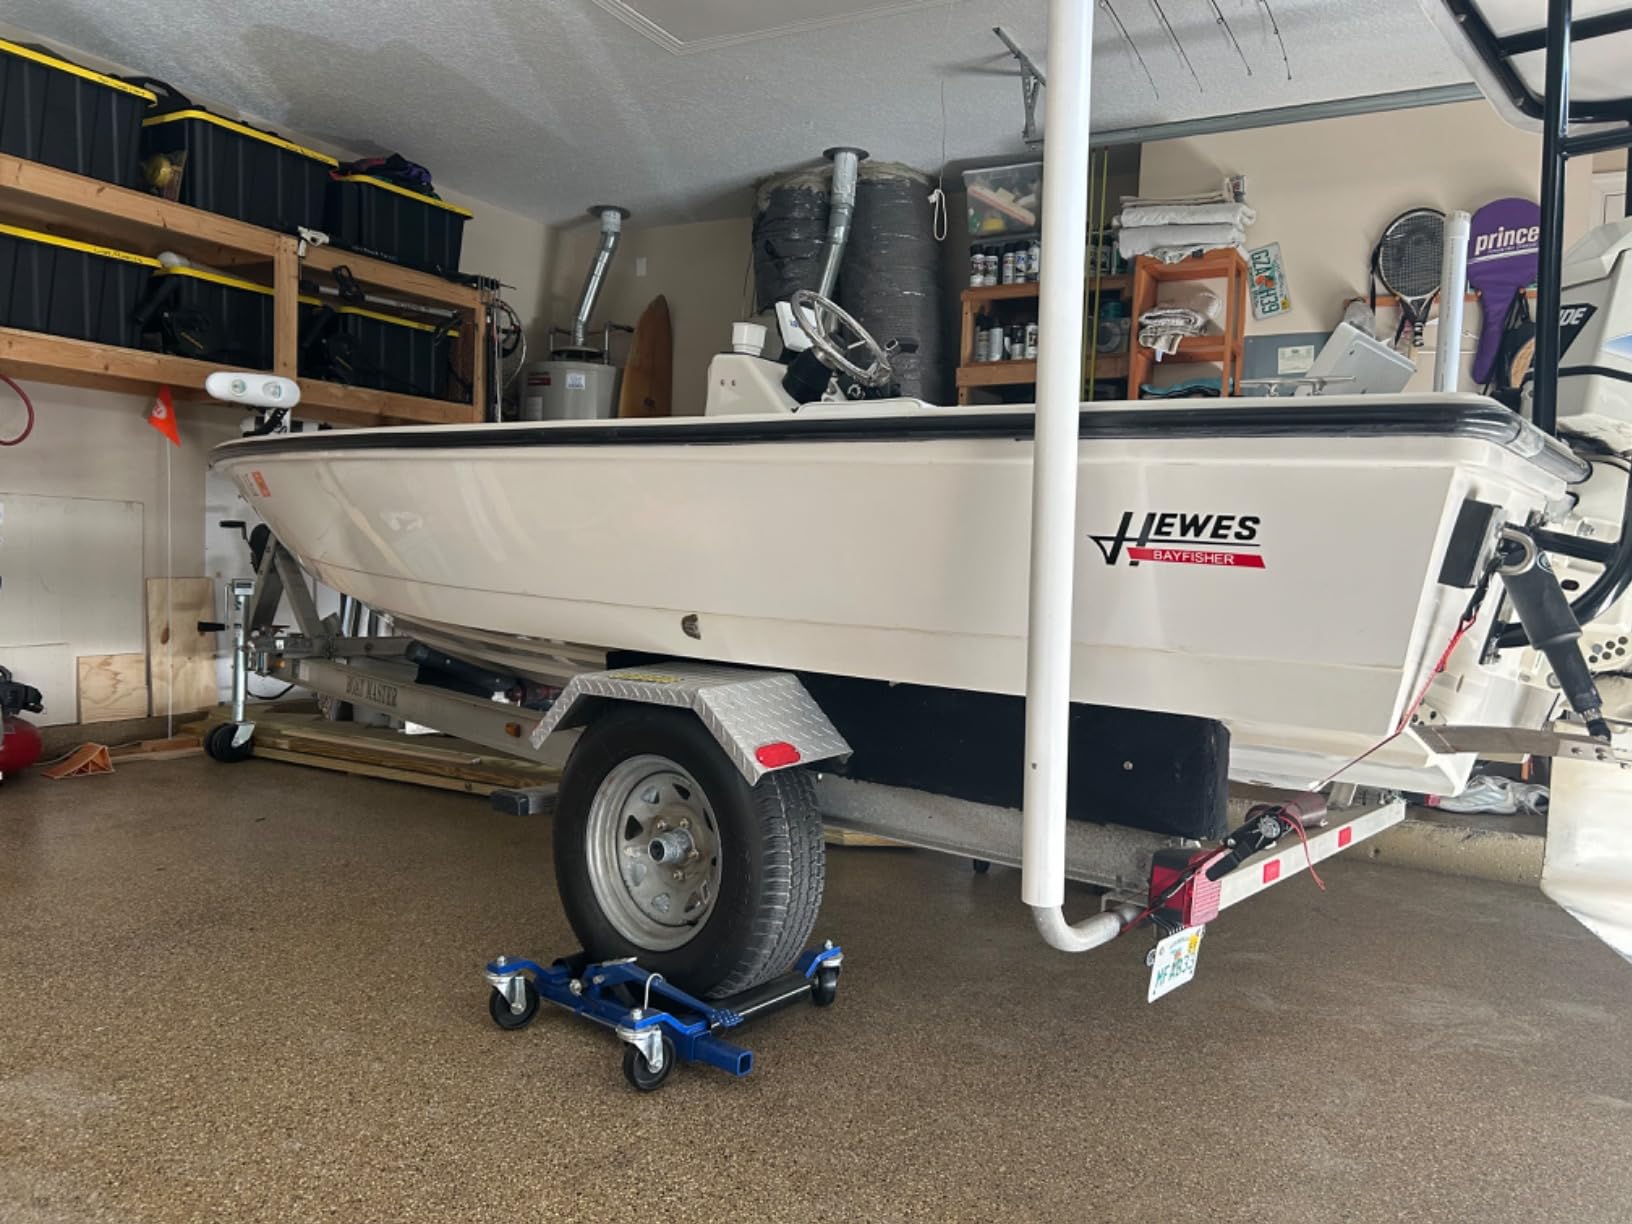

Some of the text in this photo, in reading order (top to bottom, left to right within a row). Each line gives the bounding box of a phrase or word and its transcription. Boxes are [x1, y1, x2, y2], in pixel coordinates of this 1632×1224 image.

[1474, 226, 1540, 256] prince
[1087, 511, 1261, 567] HEWES
[1152, 550, 1236, 565] BAYFISHER
